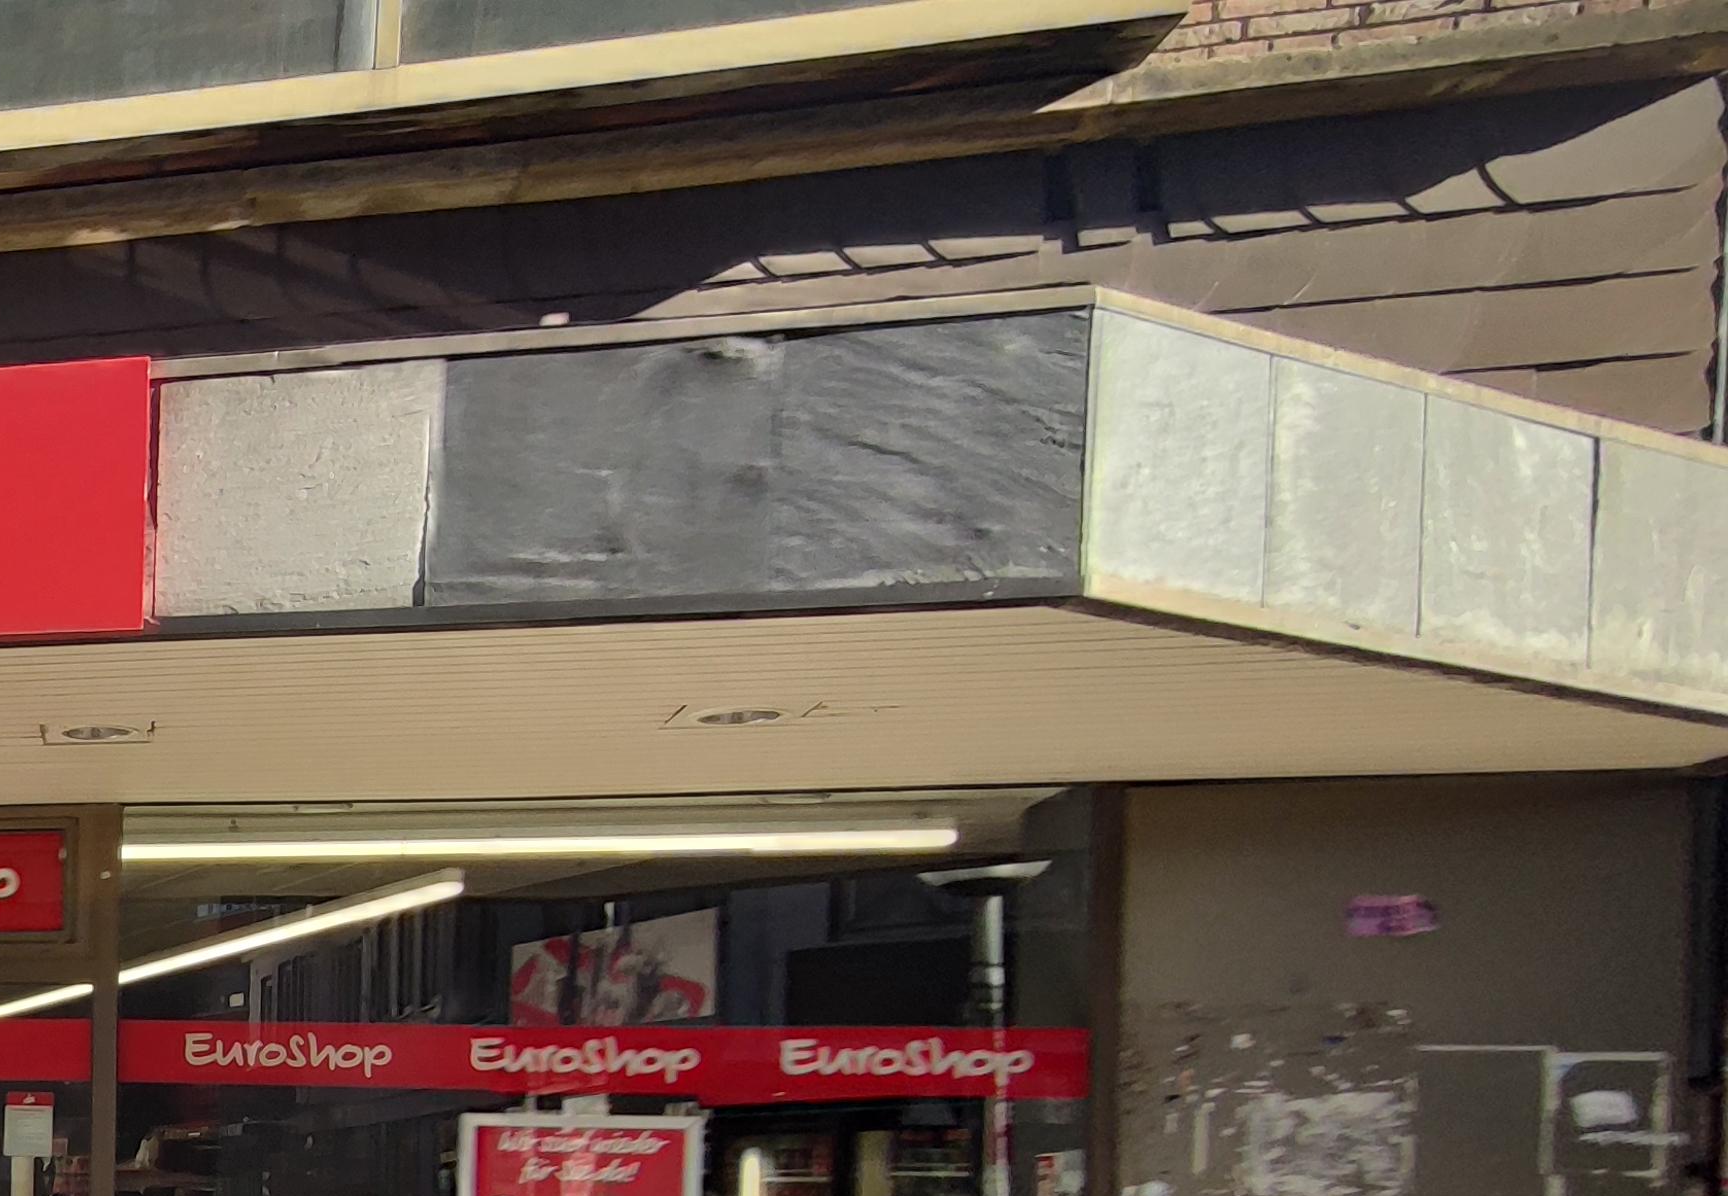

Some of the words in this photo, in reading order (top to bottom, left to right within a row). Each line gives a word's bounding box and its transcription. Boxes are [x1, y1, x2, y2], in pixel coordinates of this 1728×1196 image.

[183, 1032, 393, 1078] EuroShop
[469, 1036, 701, 1085] EuroShop
[779, 1037, 1035, 1087] EuroShop
